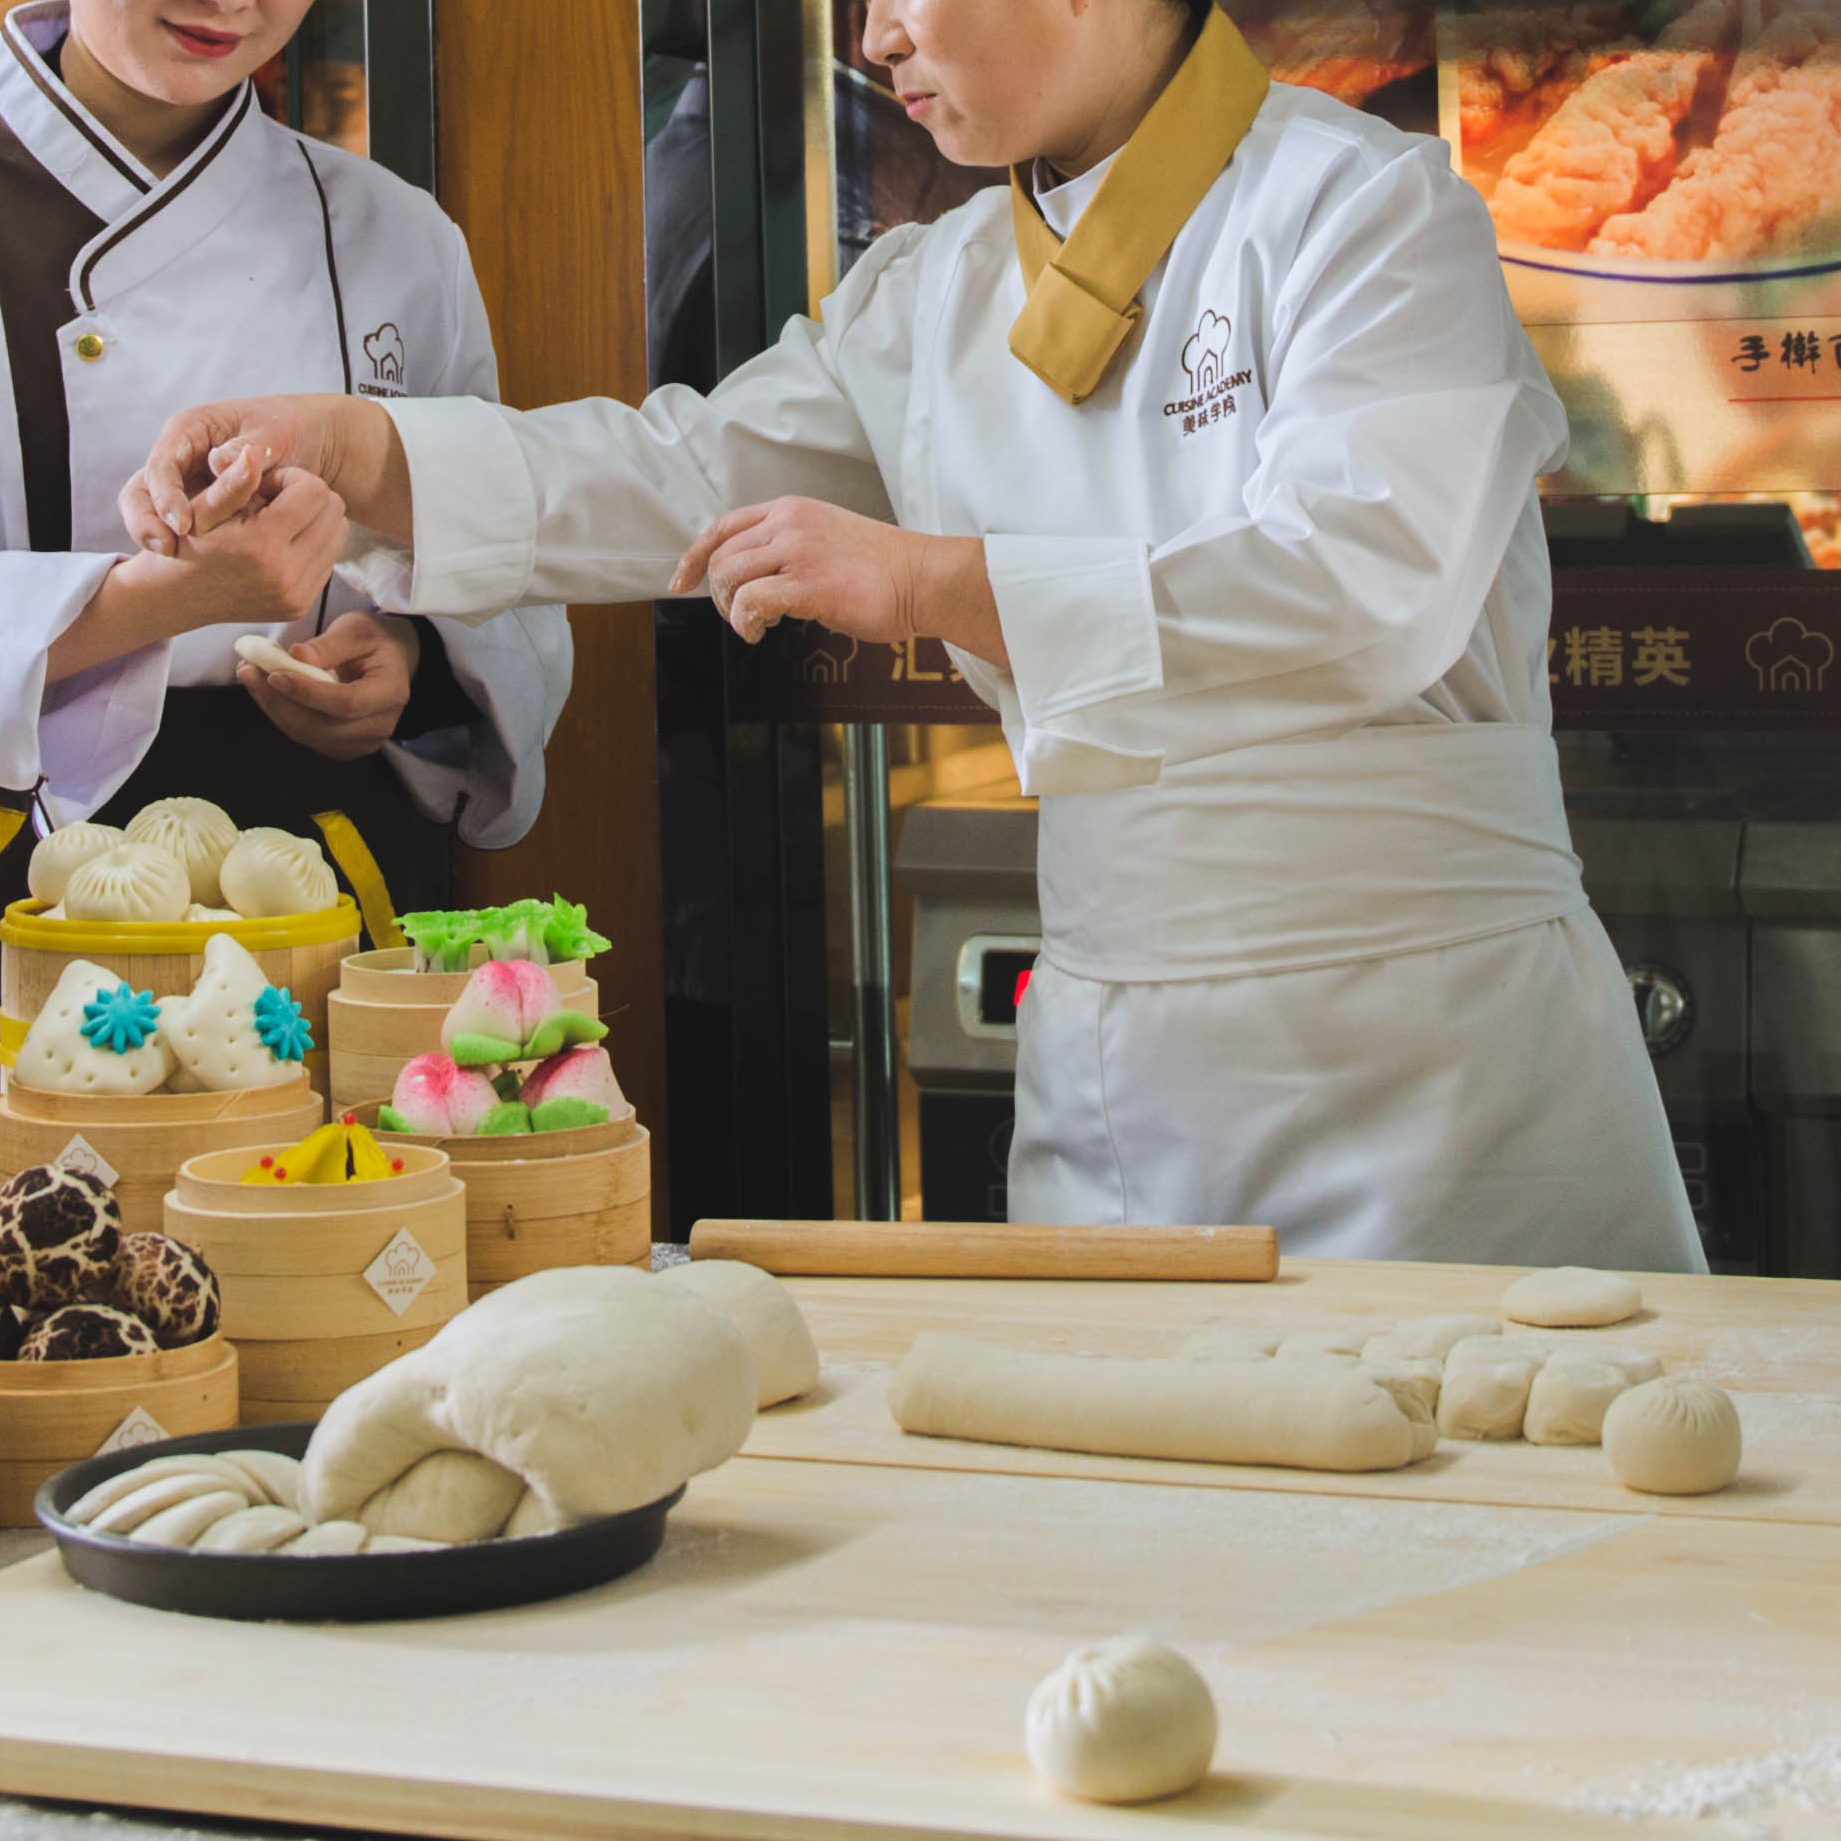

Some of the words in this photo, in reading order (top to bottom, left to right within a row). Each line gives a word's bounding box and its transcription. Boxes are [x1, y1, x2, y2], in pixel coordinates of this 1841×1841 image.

[1163, 393, 1204, 416] CUISINE
[1205, 369, 1252, 403] ACADEMY
[1183, 393, 1237, 437] 美味学院
[890, 632, 963, 682] 汇
